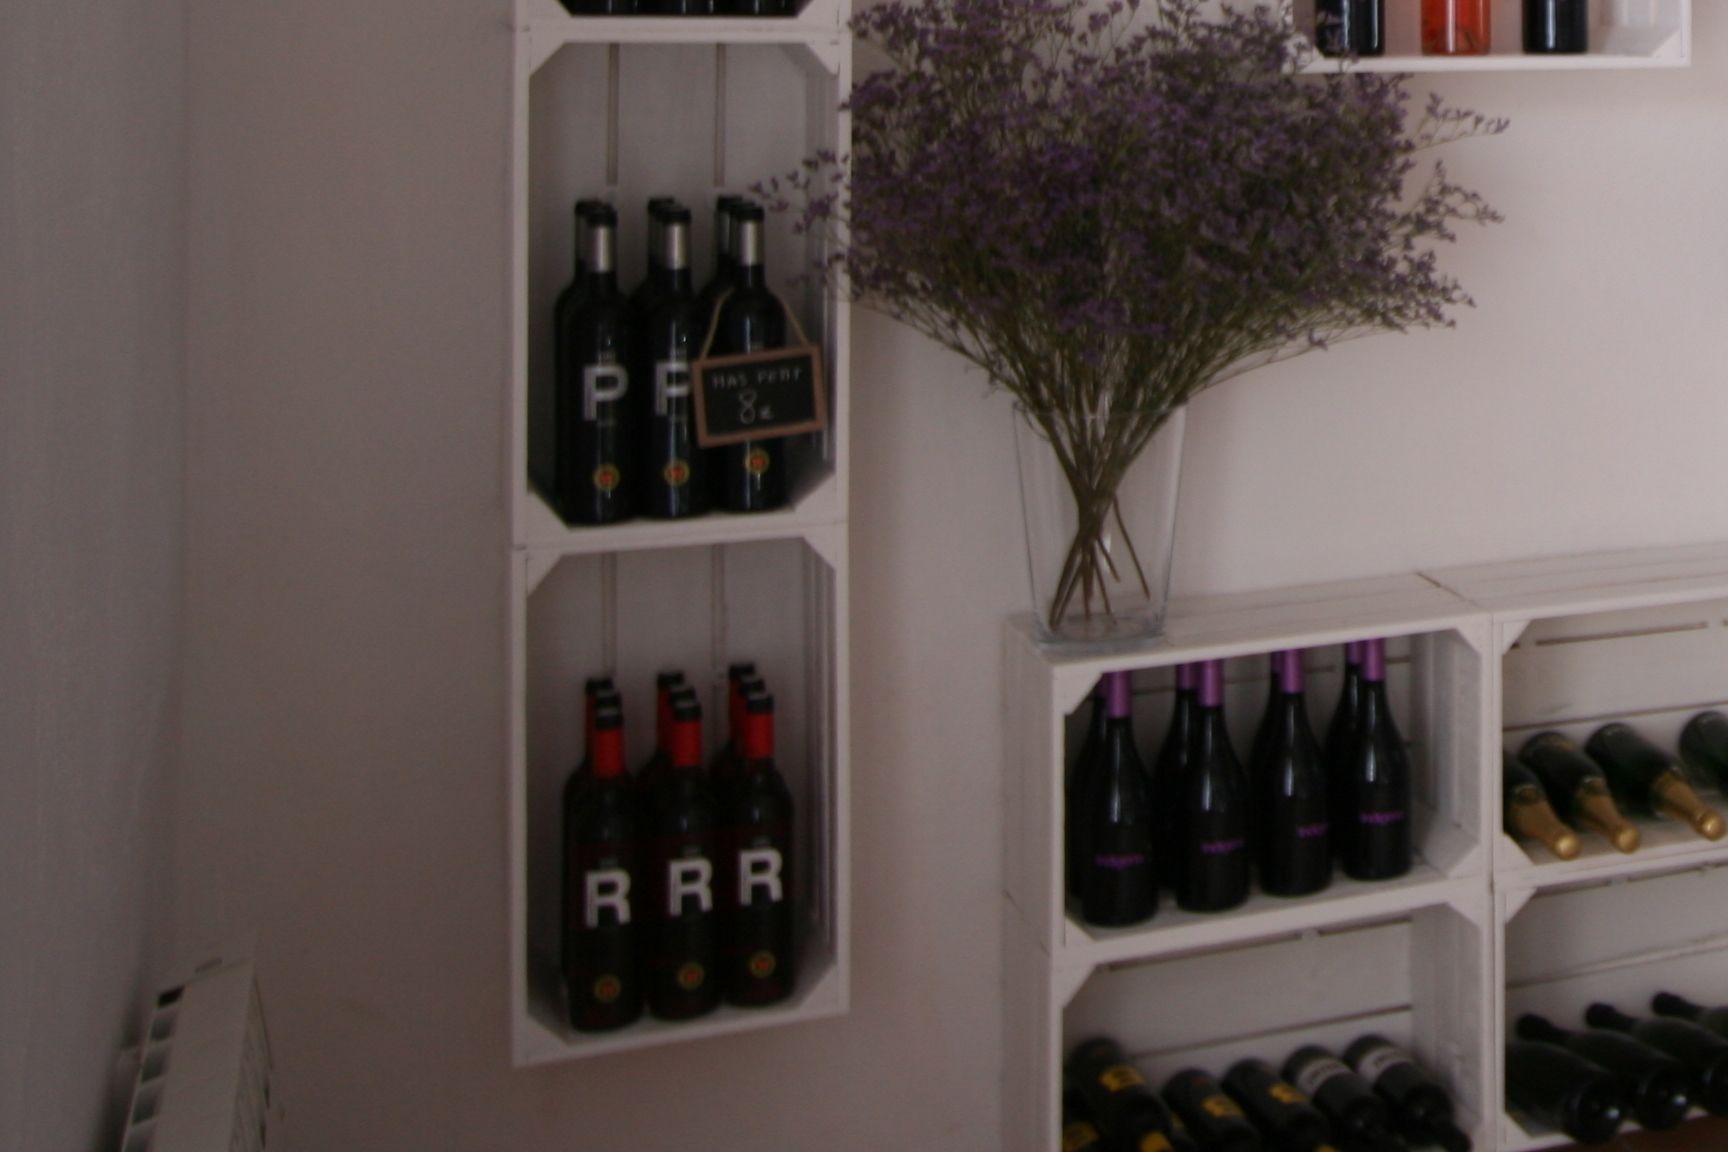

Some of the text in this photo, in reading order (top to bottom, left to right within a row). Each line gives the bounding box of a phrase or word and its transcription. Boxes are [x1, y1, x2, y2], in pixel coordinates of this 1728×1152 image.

[582, 363, 629, 422] P
[584, 867, 632, 928] R
[668, 857, 714, 917] R
[739, 847, 784, 906] R
